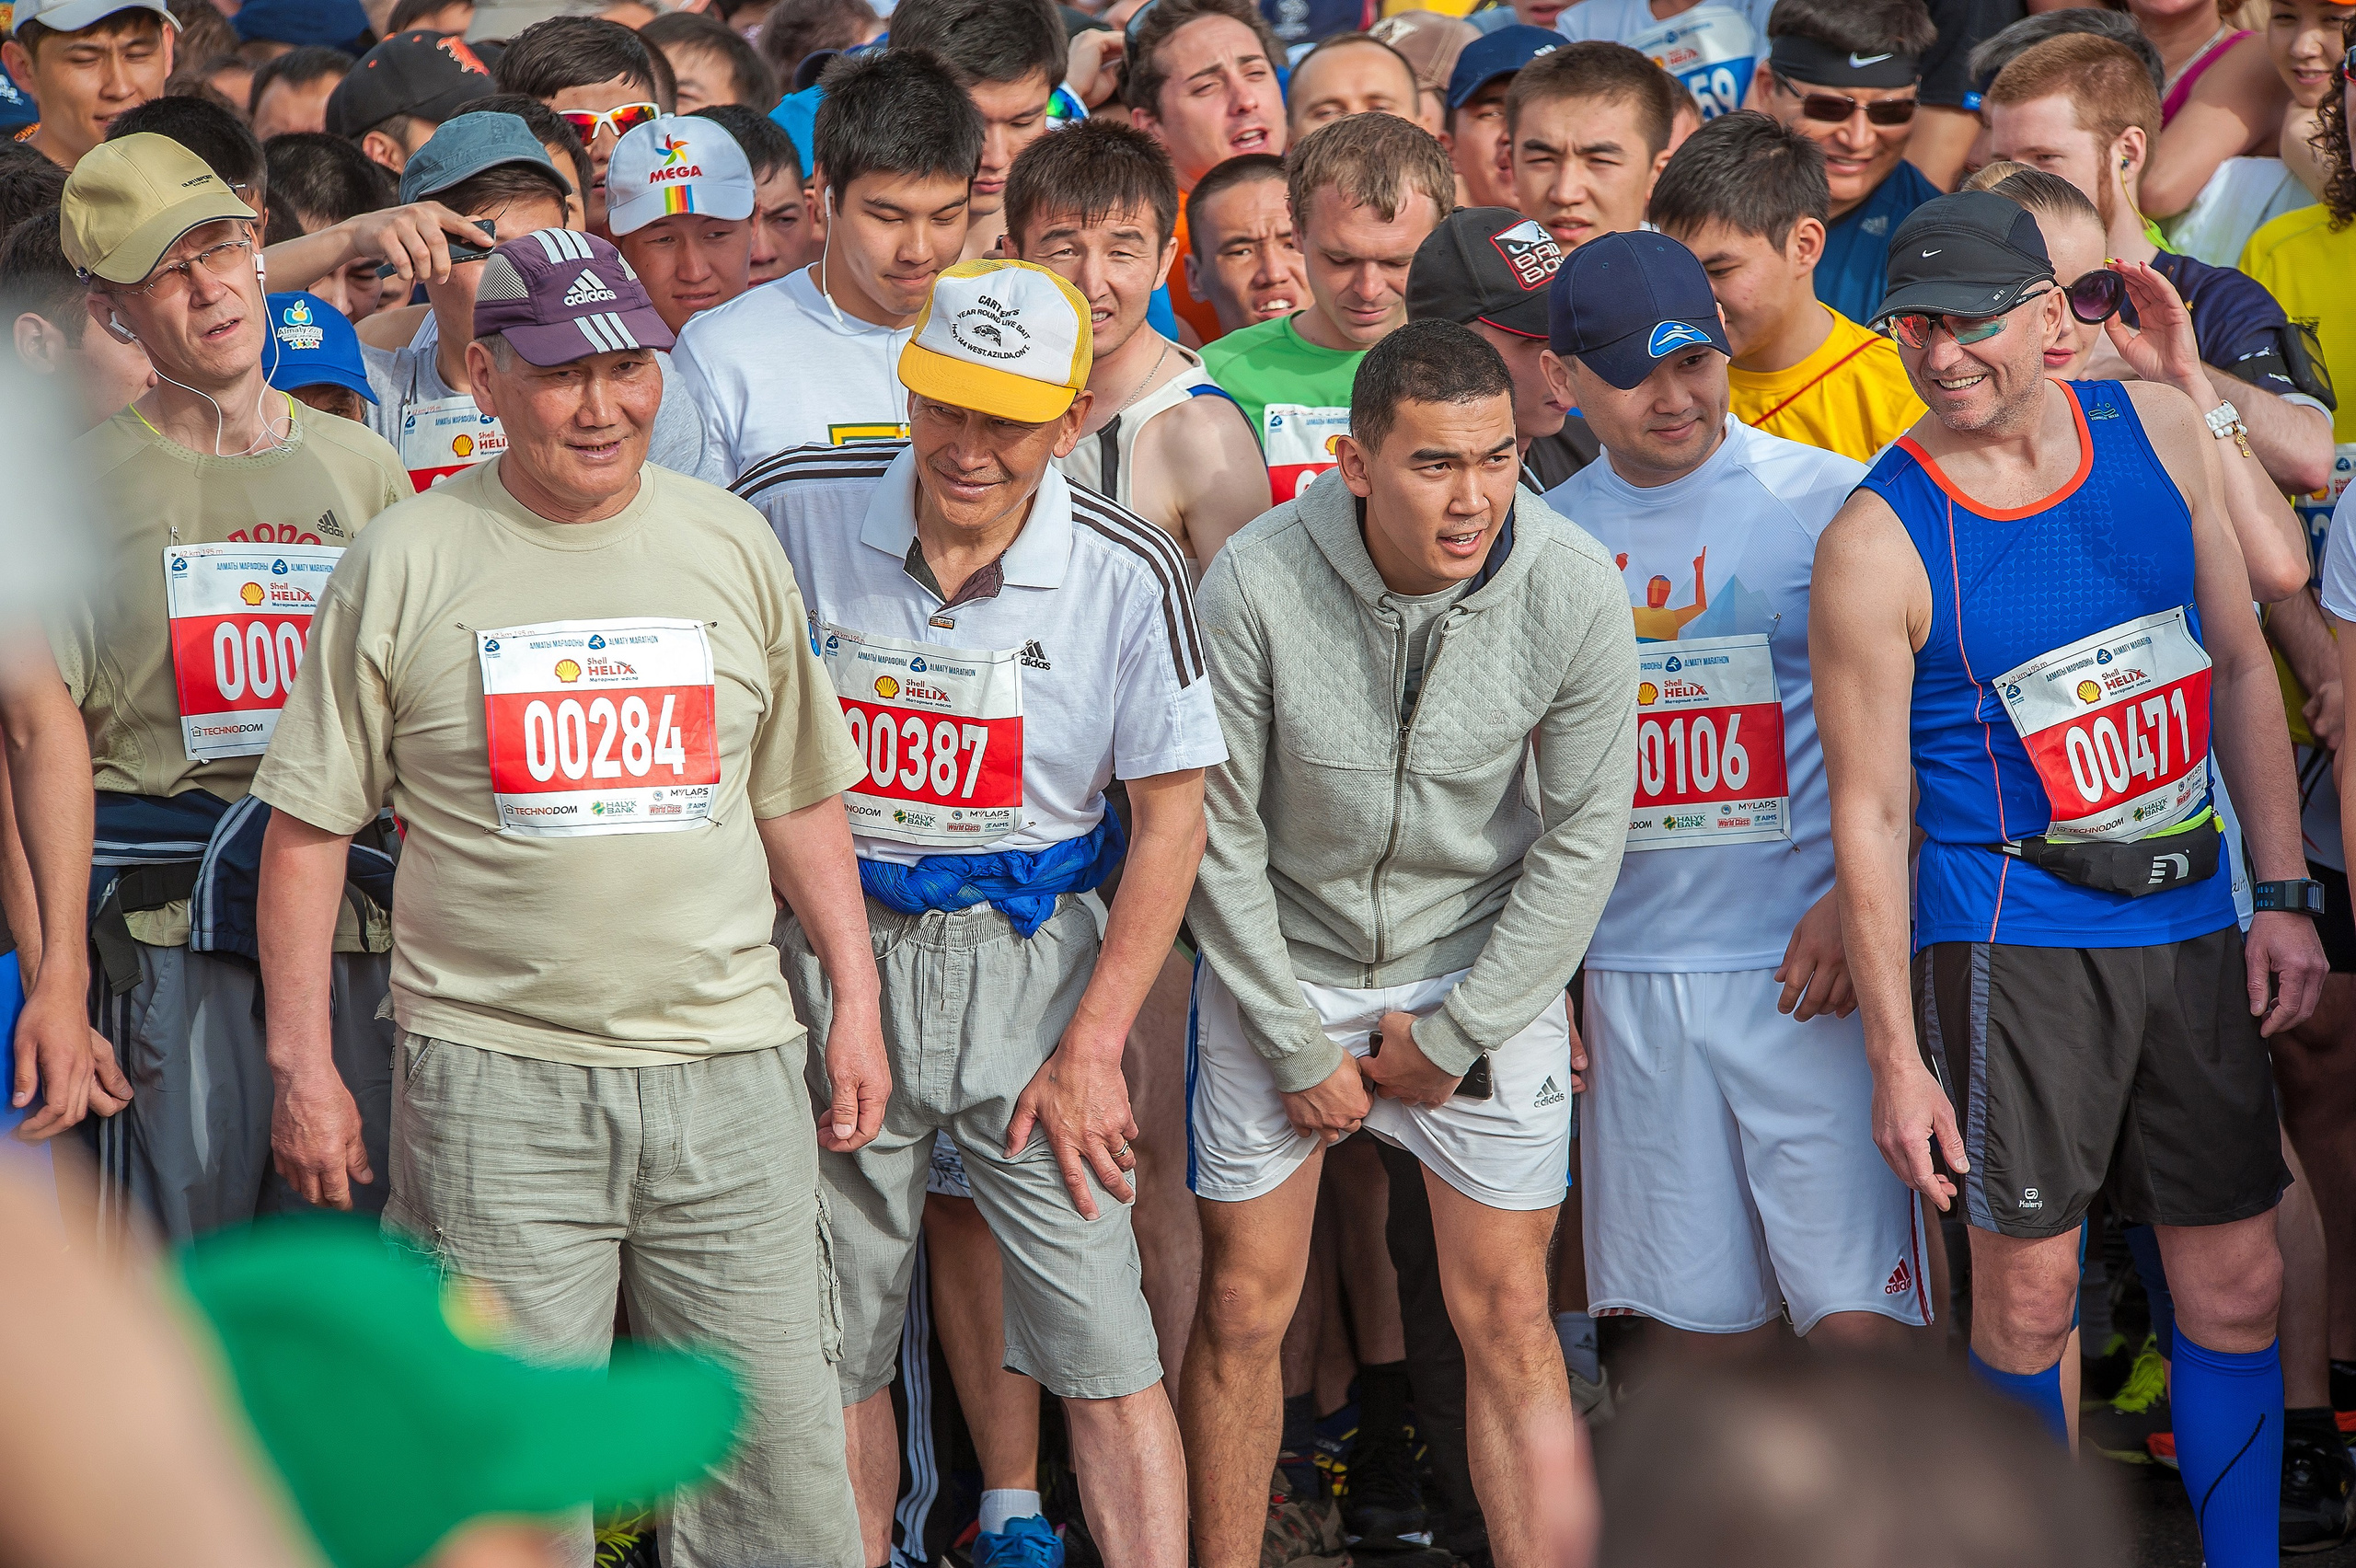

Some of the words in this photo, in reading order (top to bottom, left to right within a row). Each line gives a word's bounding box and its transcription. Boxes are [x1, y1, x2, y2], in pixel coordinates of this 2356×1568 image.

[649, 165, 703, 184] MEGA
[1512, 242, 1562, 271] BAD
[562, 287, 618, 307] adidas
[957, 308, 976, 319] YEAR
[976, 308, 1001, 324] ROUND
[1001, 319, 1017, 329] LIVE
[1015, 324, 1031, 340] BAIT
[479, 438, 507, 450] HELI
[317, 523, 345, 538] adidas
[216, 562, 239, 571] АЛМАТЫ
[290, 563, 309, 571] ALMATY
[270, 582, 289, 591] Shell
[271, 588, 316, 602] HELIX
[529, 640, 552, 650] АЛМАТЫ
[552, 640, 584, 648] МАРАФОНЫ
[608, 637, 629, 646] ALMATY
[629, 635, 659, 644] MARATHON
[2113, 642, 2131, 656] ALMATY
[213, 620, 311, 701] 000
[587, 657, 607, 665] Shell
[857, 651, 878, 663] АЛМАТЫ
[878, 654, 907, 666] МАРАФОНЫ
[1021, 655, 1051, 670] didas
[1684, 657, 1703, 667] ALMATY
[1703, 656, 1730, 665] MARATHON
[588, 662, 637, 676] HELIX
[930, 663, 949, 674] ALMATY
[949, 665, 976, 676] MARATHON
[1640, 662, 1663, 671] РАФОНЫ
[2102, 668, 2121, 681] Shell
[2104, 668, 2148, 691] HELIX
[906, 678, 926, 687] Shell
[1664, 679, 1682, 687] Shell
[906, 685, 952, 702] HELIX
[1664, 685, 1708, 698] HELIX
[202, 723, 264, 736] TECHNODOM
[524, 694, 687, 782] 00284
[2065, 687, 2190, 803] 00471
[1635, 713, 1750, 797] 0106
[670, 788, 710, 797] MYLAPS
[514, 805, 578, 816] TECHNODOM
[606, 799, 637, 809] HALYK
[606, 806, 636, 814] BANK
[1738, 800, 1777, 811] MYLAPS
[2143, 797, 2169, 811] HALYK
[2144, 803, 2169, 818] BANK
[907, 812, 936, 824] HALYK
[907, 817, 933, 828] BANK
[1676, 814, 1706, 823] HALYK
[1677, 820, 1704, 828] BANK
[2068, 816, 2125, 835] TECHNODOM
[2018, 1199, 2044, 1211] Kalenji
